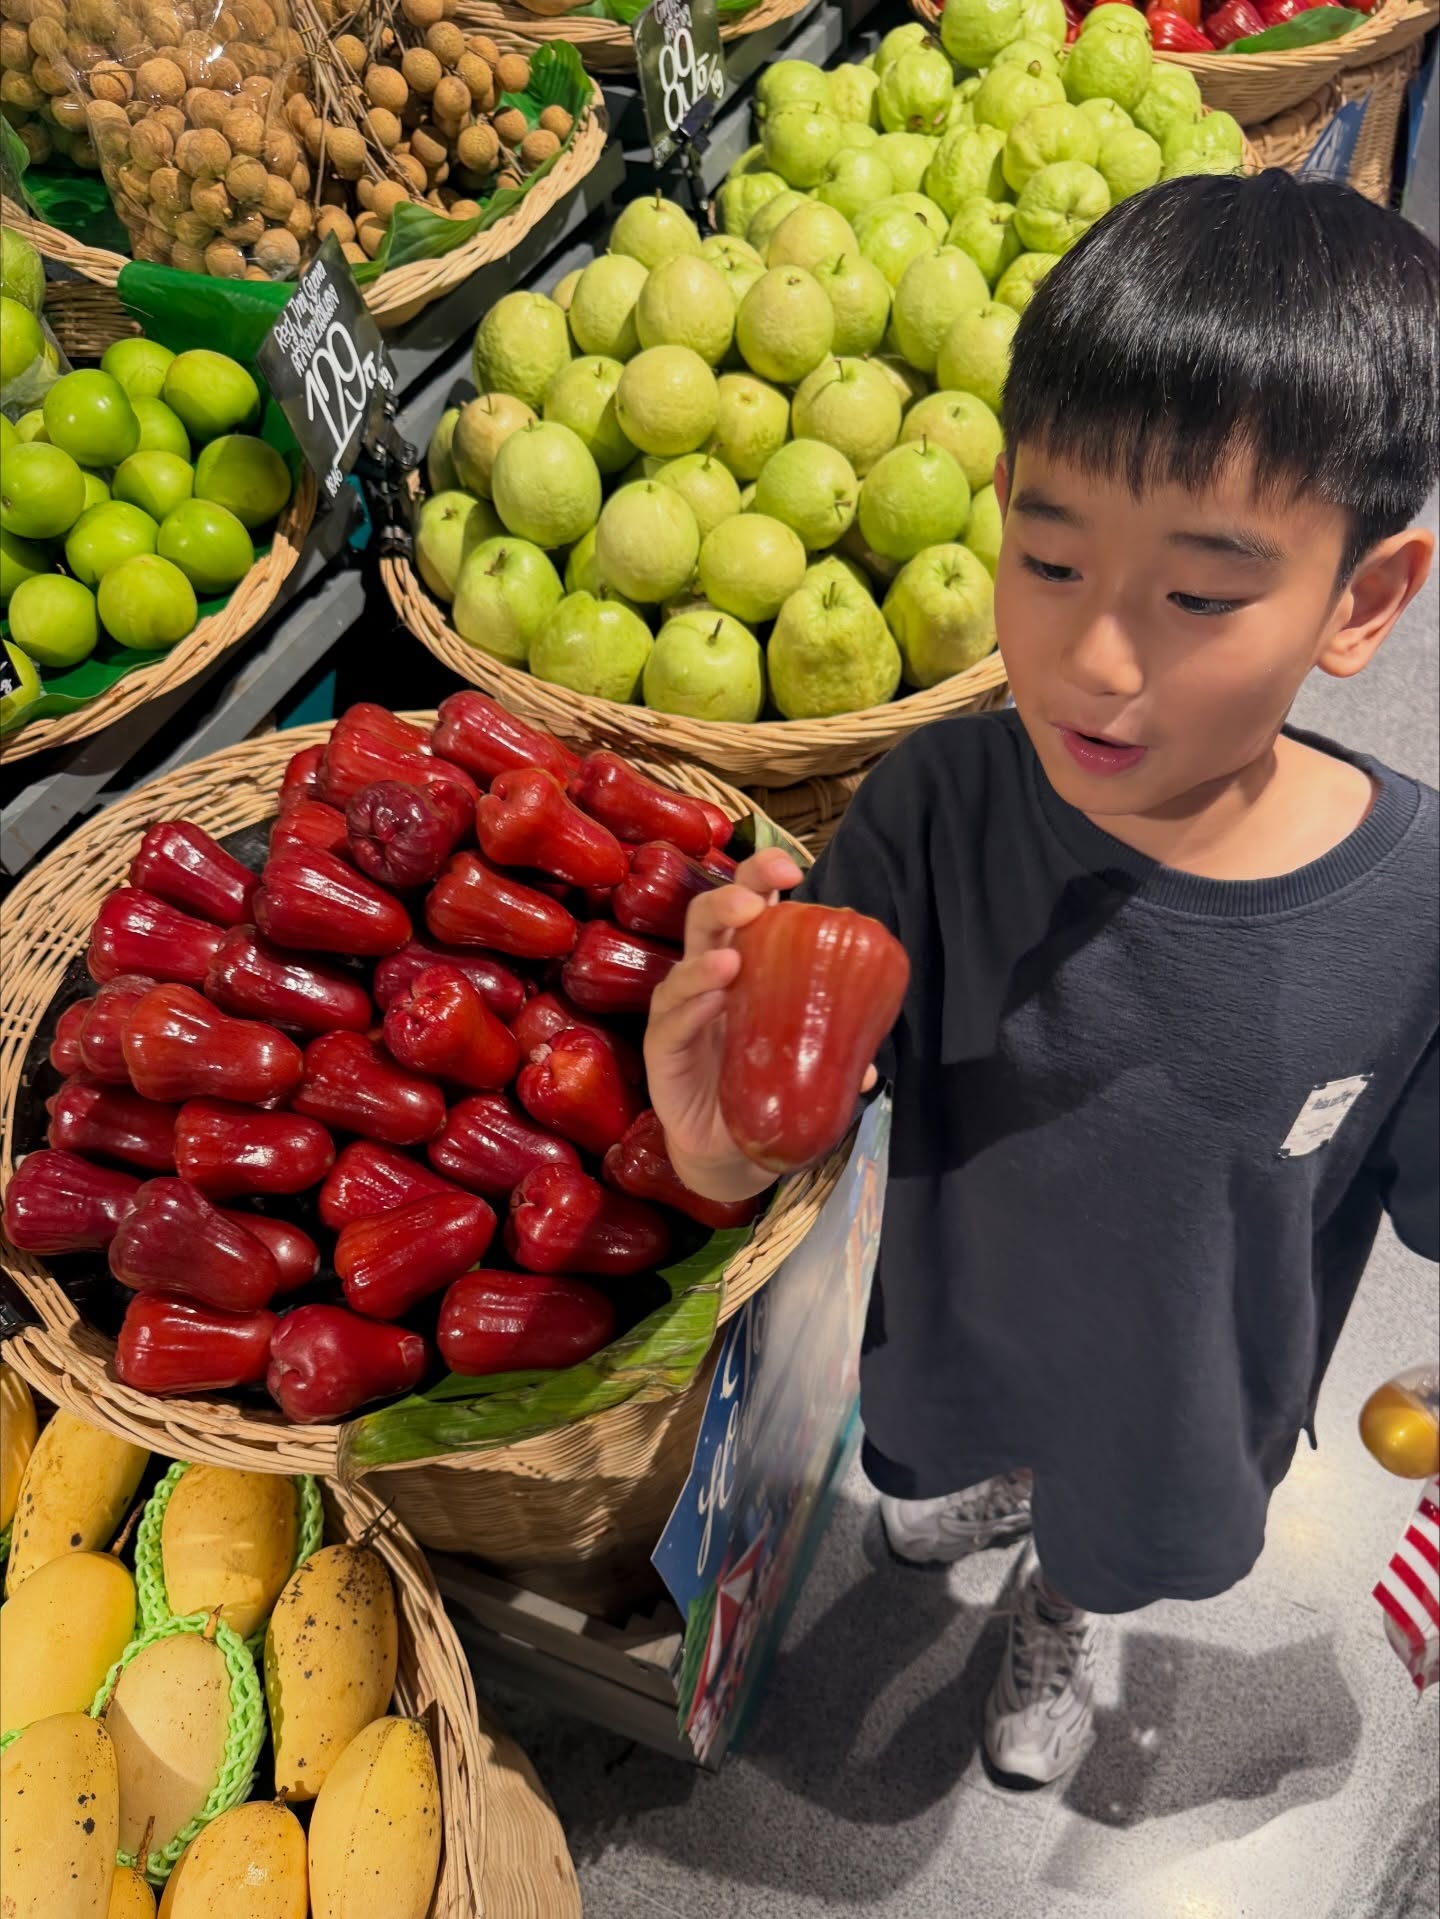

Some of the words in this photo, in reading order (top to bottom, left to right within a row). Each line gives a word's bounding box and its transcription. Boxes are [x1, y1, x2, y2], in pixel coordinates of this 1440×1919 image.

[273, 311, 296, 354] Red
[287, 287, 309, 323] Thai
[304, 321, 368, 452] 129
